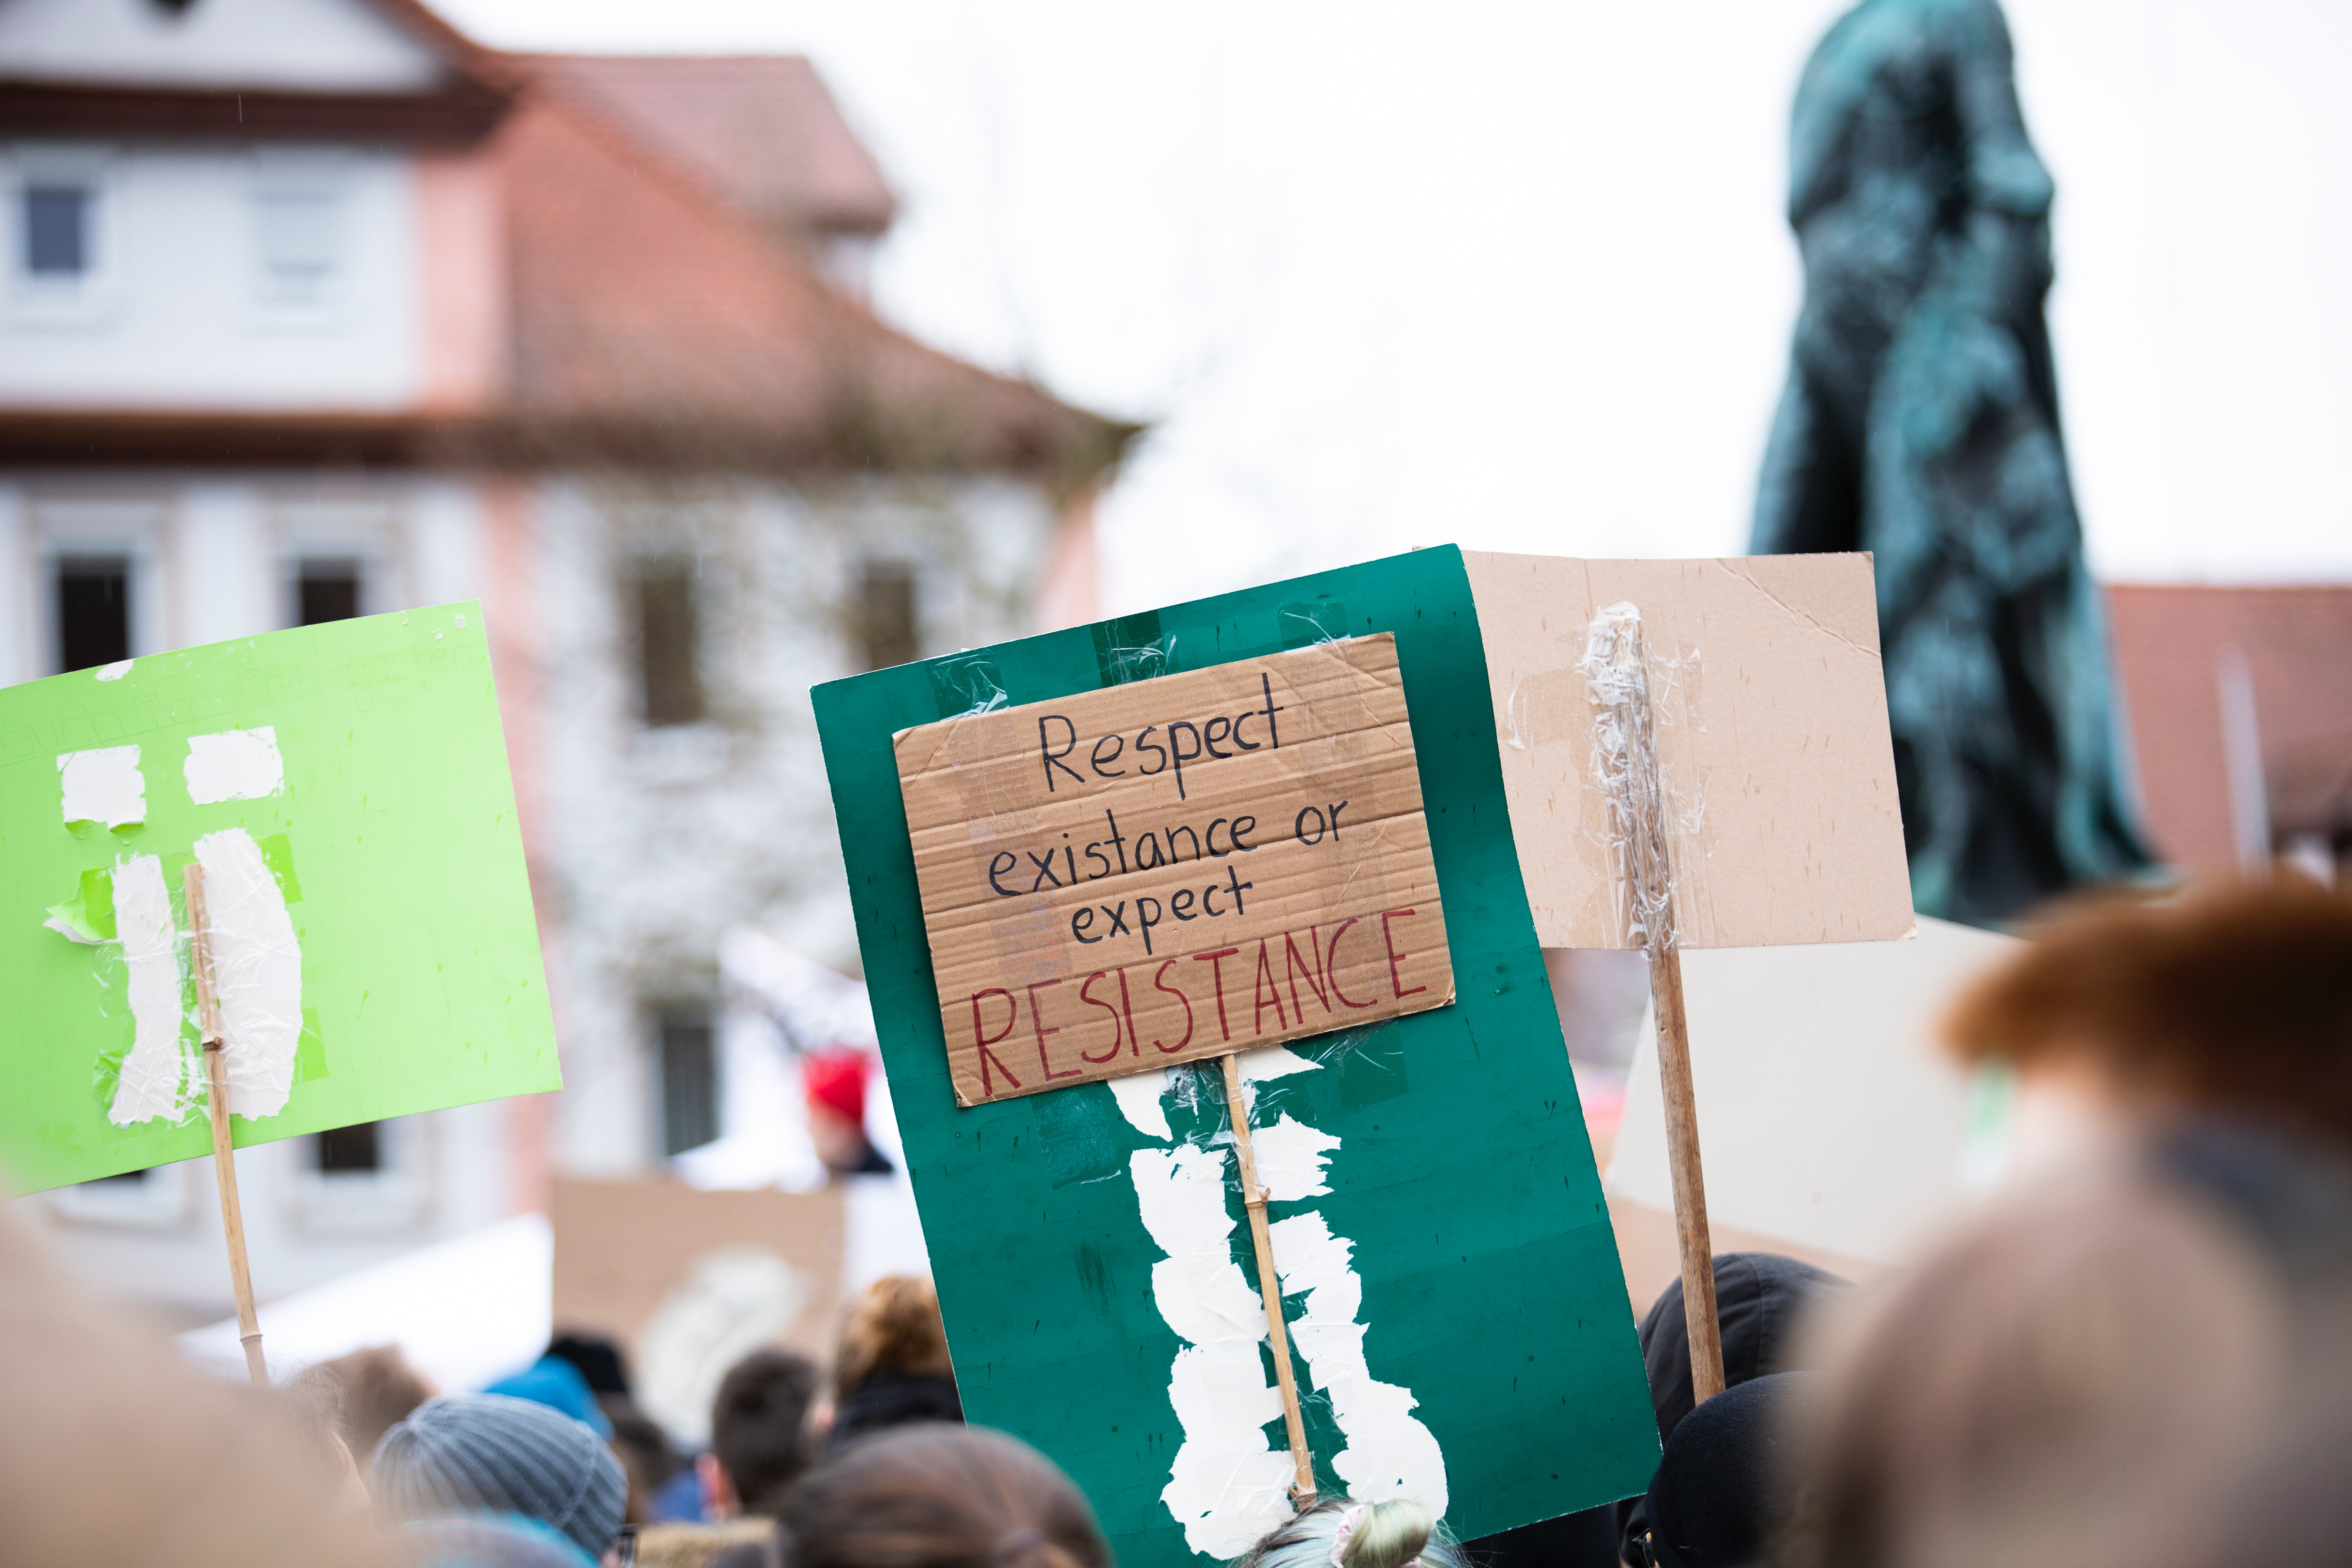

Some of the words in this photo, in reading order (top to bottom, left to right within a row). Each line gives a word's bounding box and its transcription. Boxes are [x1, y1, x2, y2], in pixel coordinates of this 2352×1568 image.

[1039, 673, 1284, 800] Respect
[989, 809, 1257, 896] existance
[1295, 800, 1348, 845] or
[1072, 866, 1252, 955] expect
[972, 909, 1427, 1096] RESISTANCE
